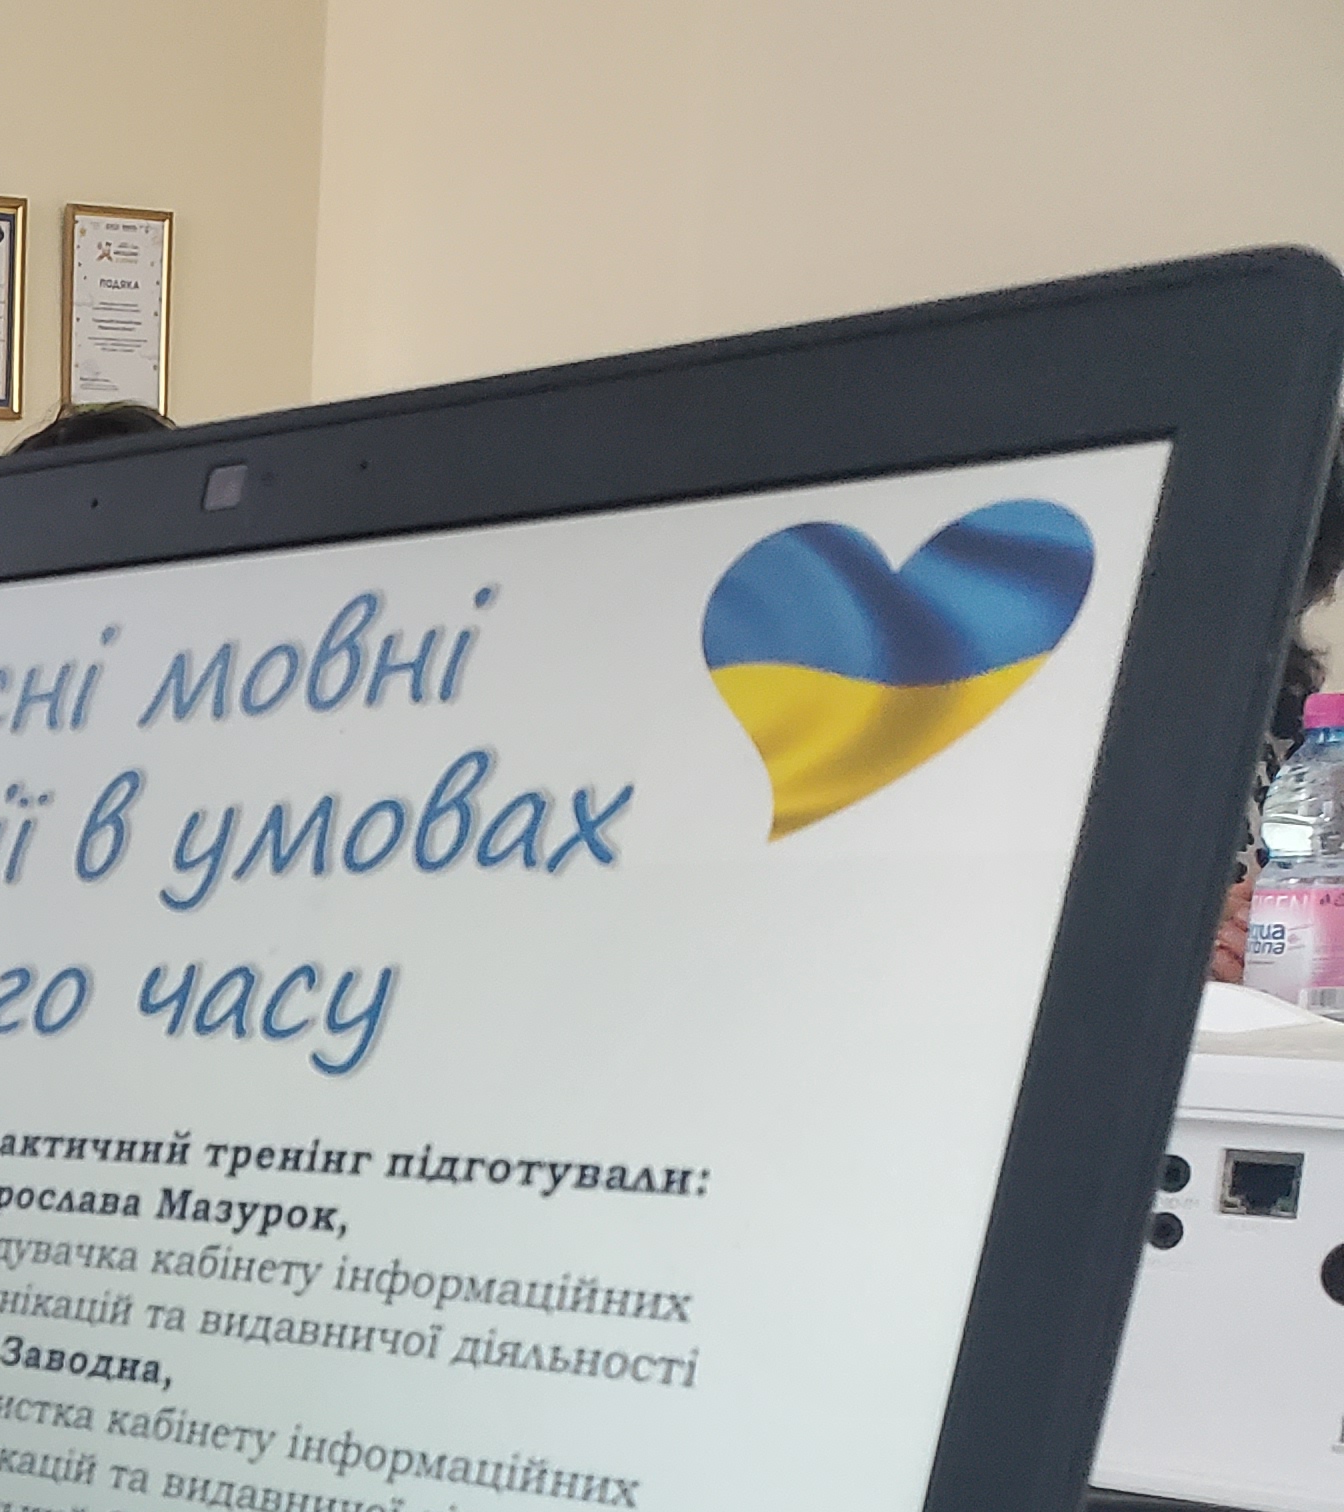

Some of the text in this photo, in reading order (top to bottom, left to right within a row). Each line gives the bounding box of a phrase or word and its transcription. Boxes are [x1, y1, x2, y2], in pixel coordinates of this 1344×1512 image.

[99, 278, 140, 290] ПОДЯКА
[137, 584, 499, 728] мовні
[74, 769, 145, 882] в
[159, 749, 635, 912] умовах
[138, 963, 399, 1076] часу
[204, 1138, 373, 1178] тренінг
[384, 1143, 712, 1200] підготували:
[155, 1187, 349, 1238] Мазурок,
[150, 1243, 323, 1297] кабінету
[335, 1254, 693, 1324] інформаційних
[0, 1335, 174, 1391] Заводна,
[145, 1302, 187, 1332] та
[198, 1308, 444, 1360] видавничої
[449, 1328, 702, 1388] діяльності
[106, 1406, 278, 1465] кабінету
[287, 1423, 643, 1509] інформаційних
[109, 1463, 150, 1495] та
